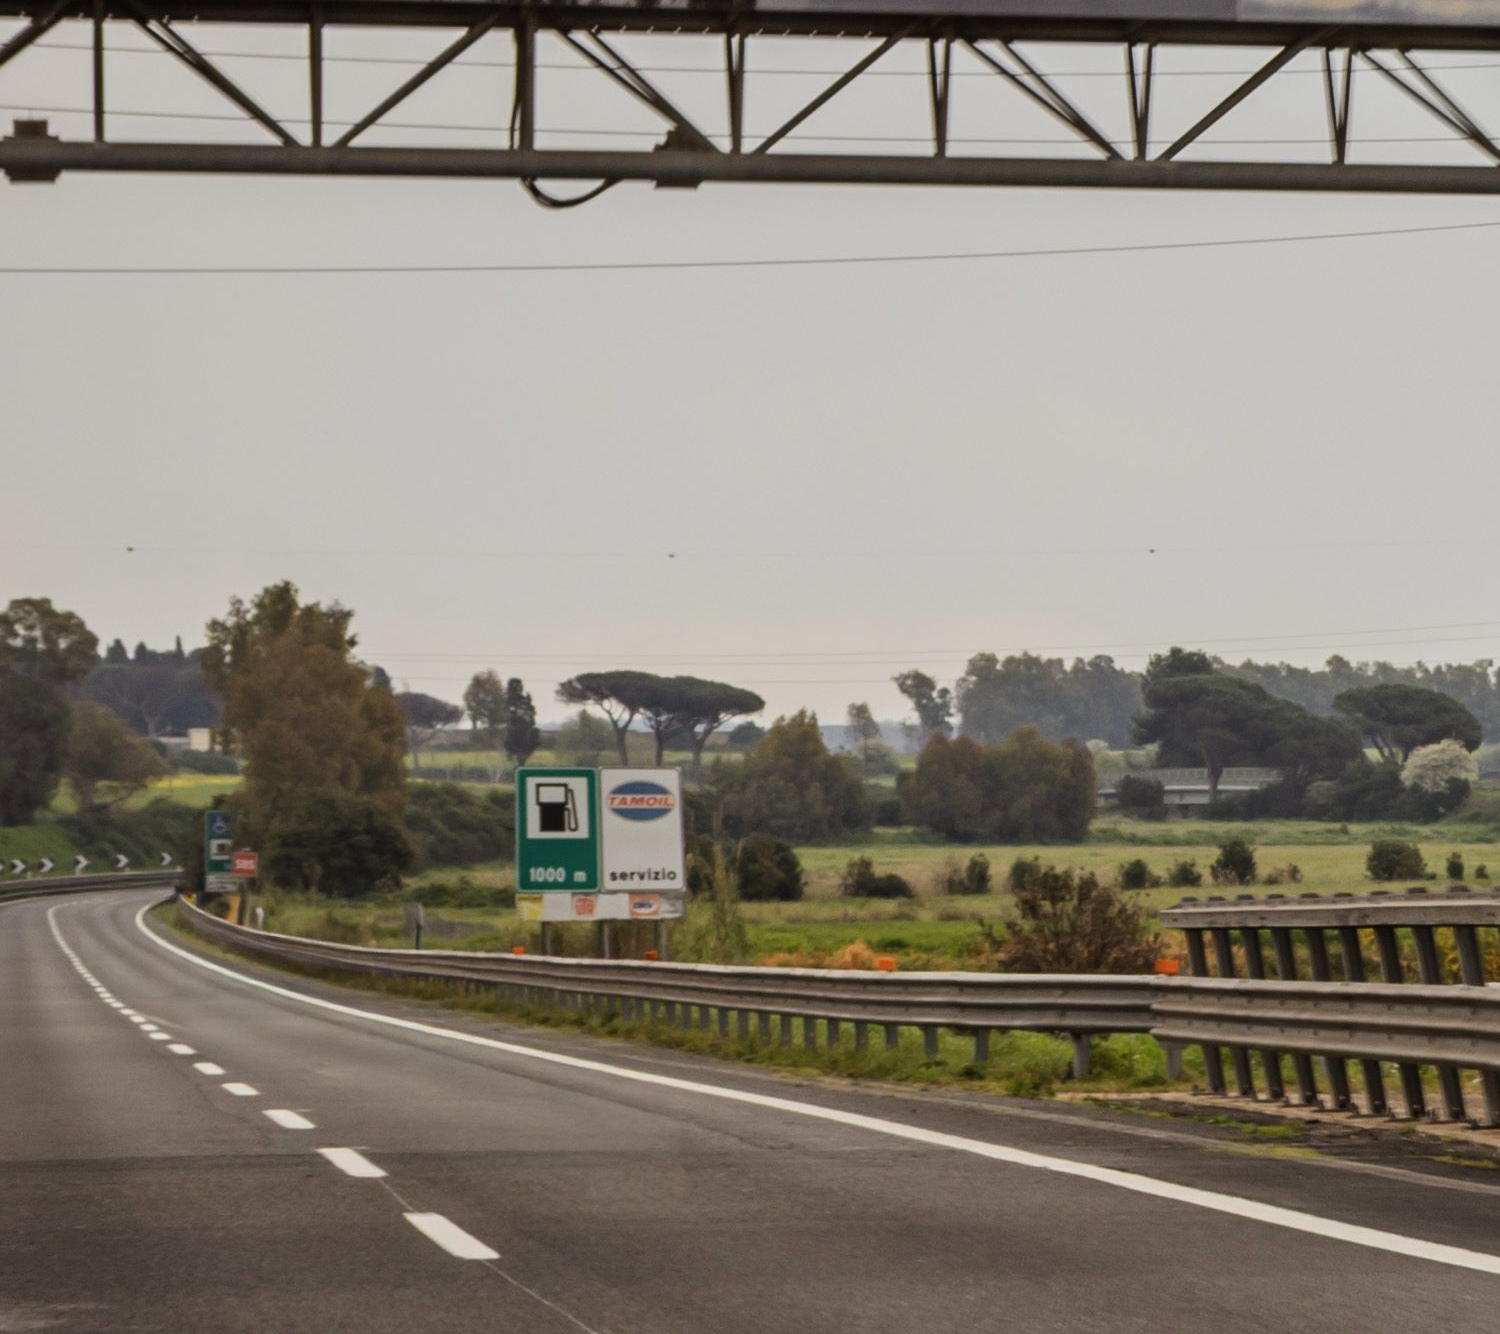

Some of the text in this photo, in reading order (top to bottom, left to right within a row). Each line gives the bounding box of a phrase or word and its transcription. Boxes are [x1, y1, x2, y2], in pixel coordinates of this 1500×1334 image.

[608, 796, 673, 807] TAMOIL
[529, 866, 587, 883] 1000 m
[609, 867, 677, 882] servizio
